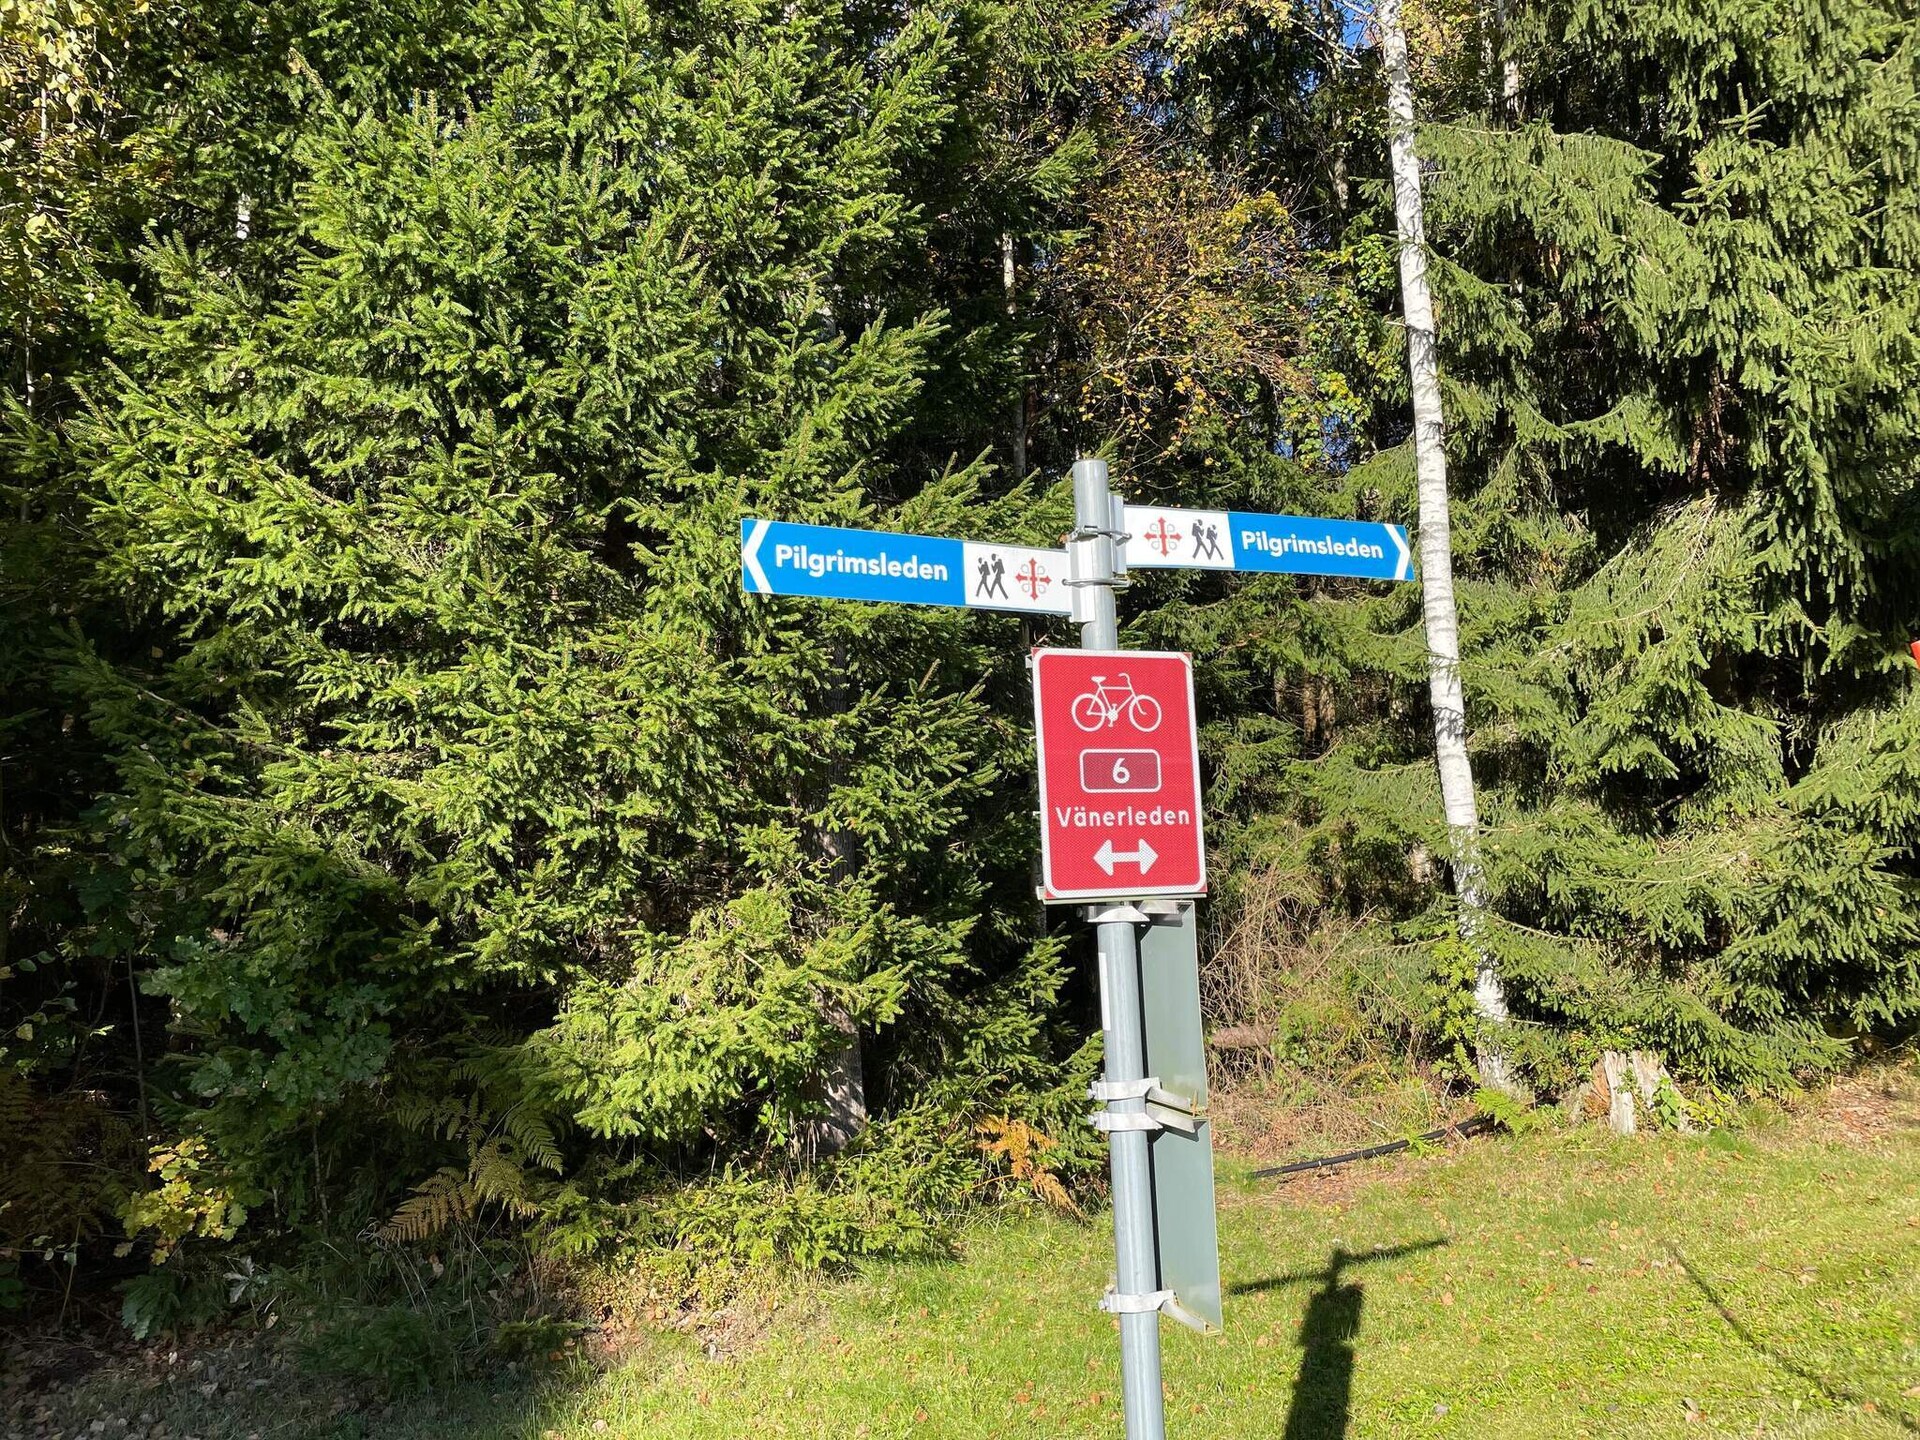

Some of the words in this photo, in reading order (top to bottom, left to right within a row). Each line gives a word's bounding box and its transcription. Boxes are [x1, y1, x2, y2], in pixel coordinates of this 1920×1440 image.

[1241, 530, 1384, 559] Pilgrimsleden
[775, 544, 948, 581] Pilgrimsleden
[1112, 757, 1131, 784] 6
[1055, 805, 1190, 828] Vänerleden
